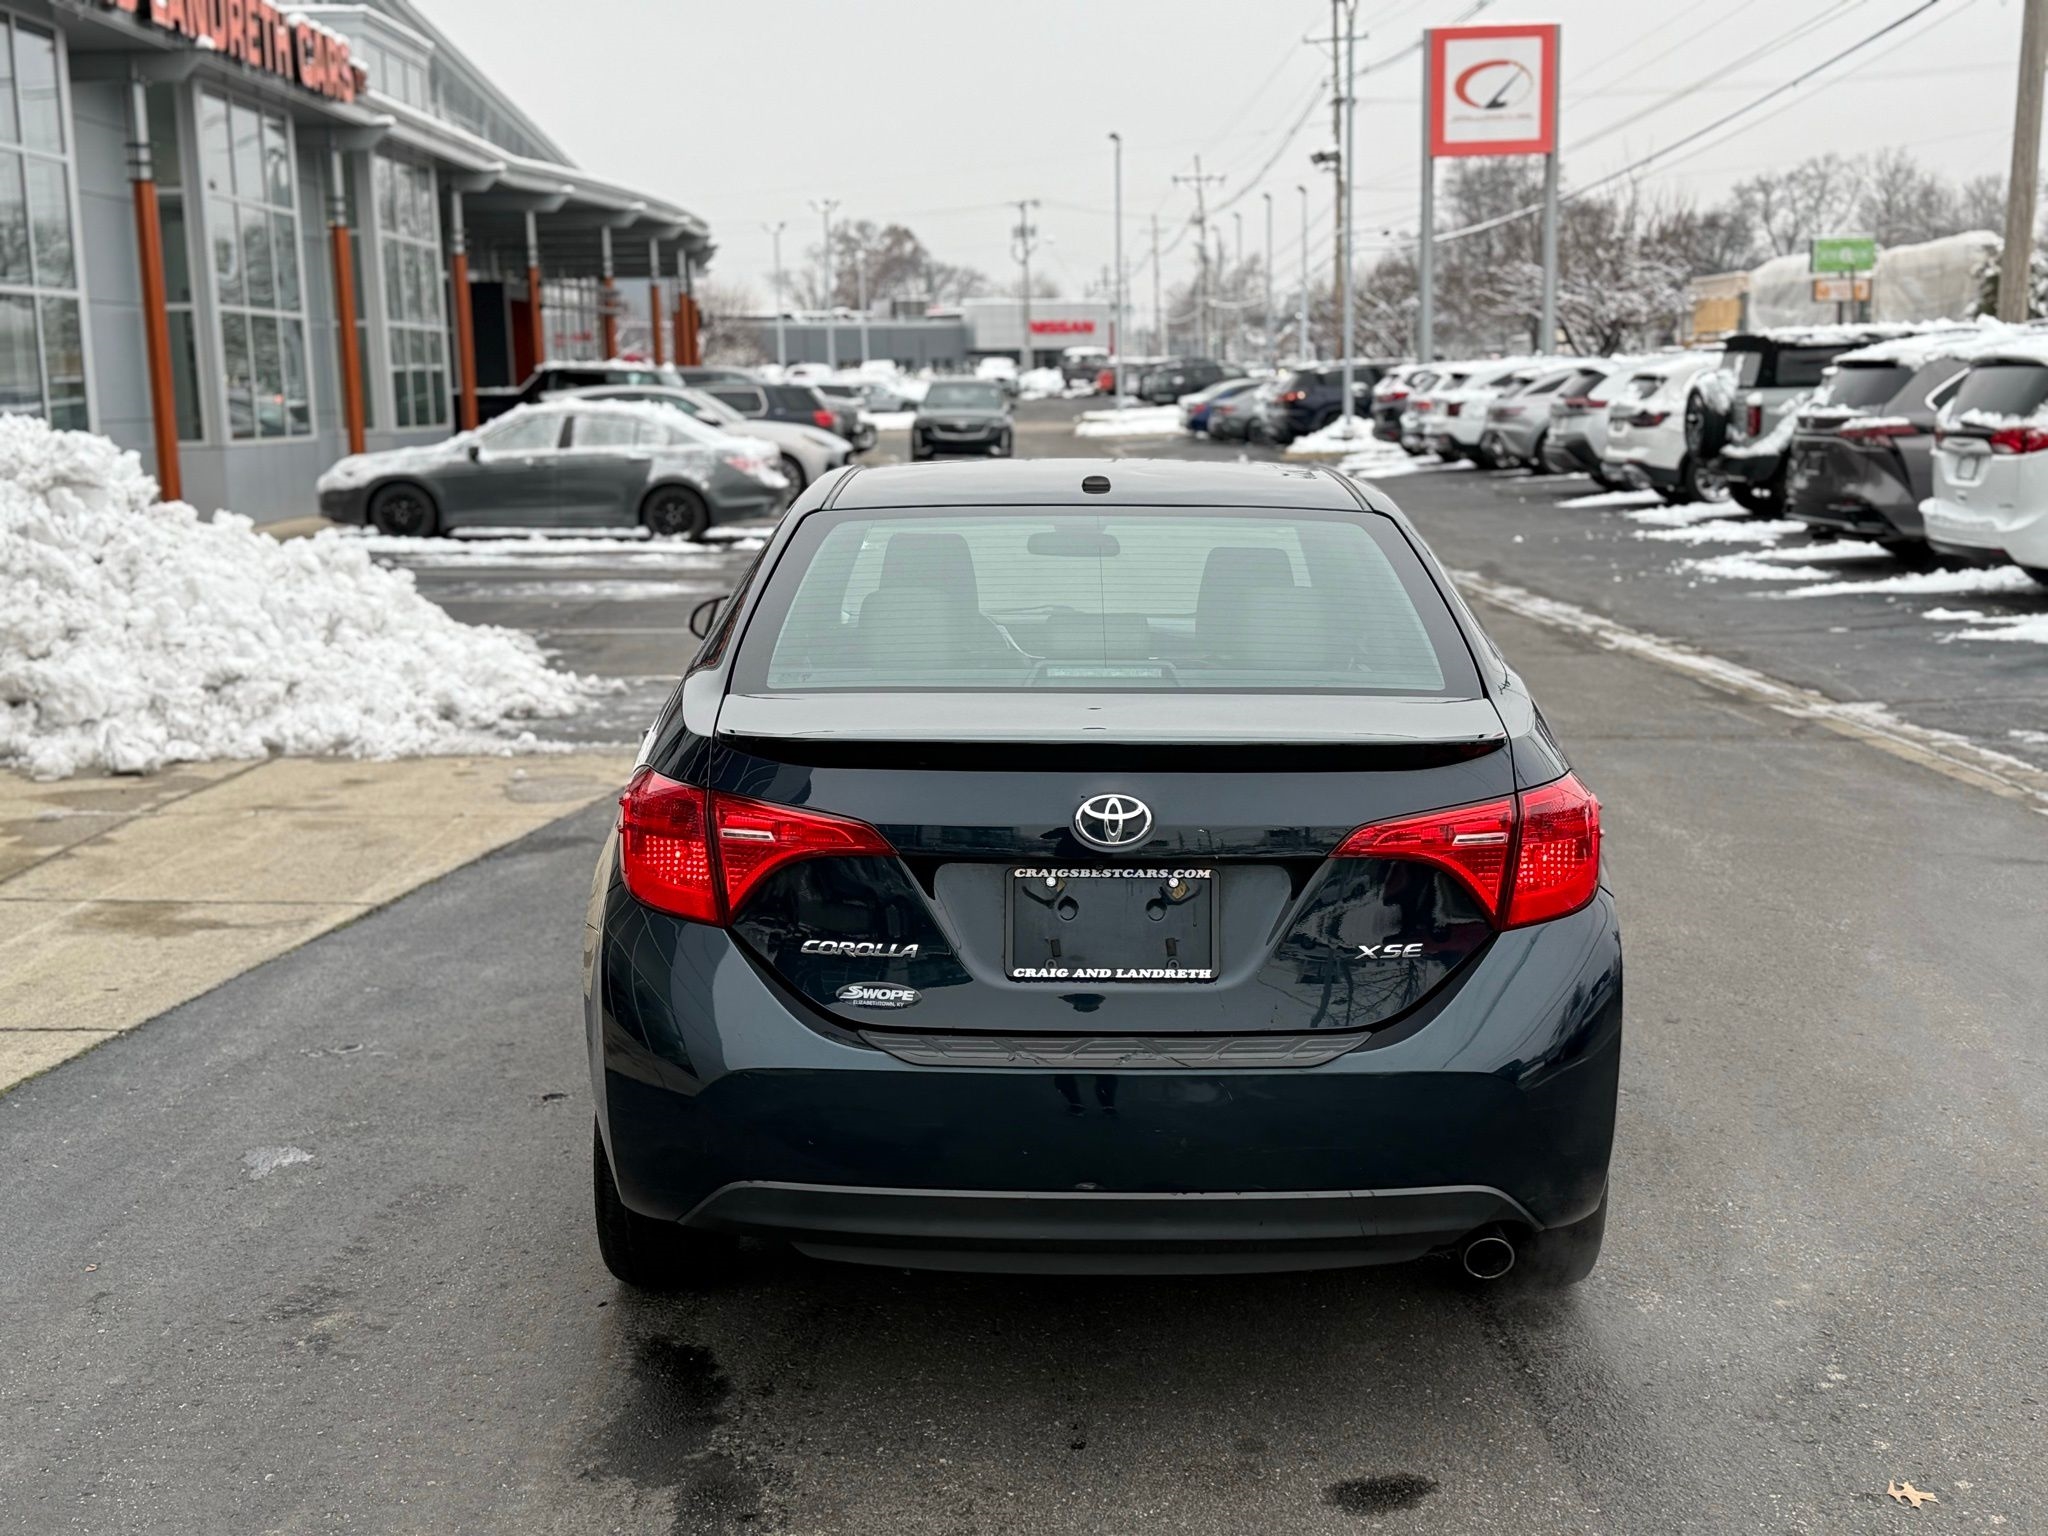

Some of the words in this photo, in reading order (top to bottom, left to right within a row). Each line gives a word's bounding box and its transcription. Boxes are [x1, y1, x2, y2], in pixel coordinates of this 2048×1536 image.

[299, 19, 354, 102] CARS
[1030, 320, 1094, 334] NISSAN
[1014, 868, 1211, 879] CRAIGSBESTCARS.COM
[800, 940, 919, 958] COROLLA
[1354, 943, 1423, 959] XSE
[1013, 967, 1069, 978] CRAIG
[1072, 968, 1112, 978] AND
[1115, 968, 1211, 979] LANDRETH
[839, 985, 915, 1001] SWOPE
